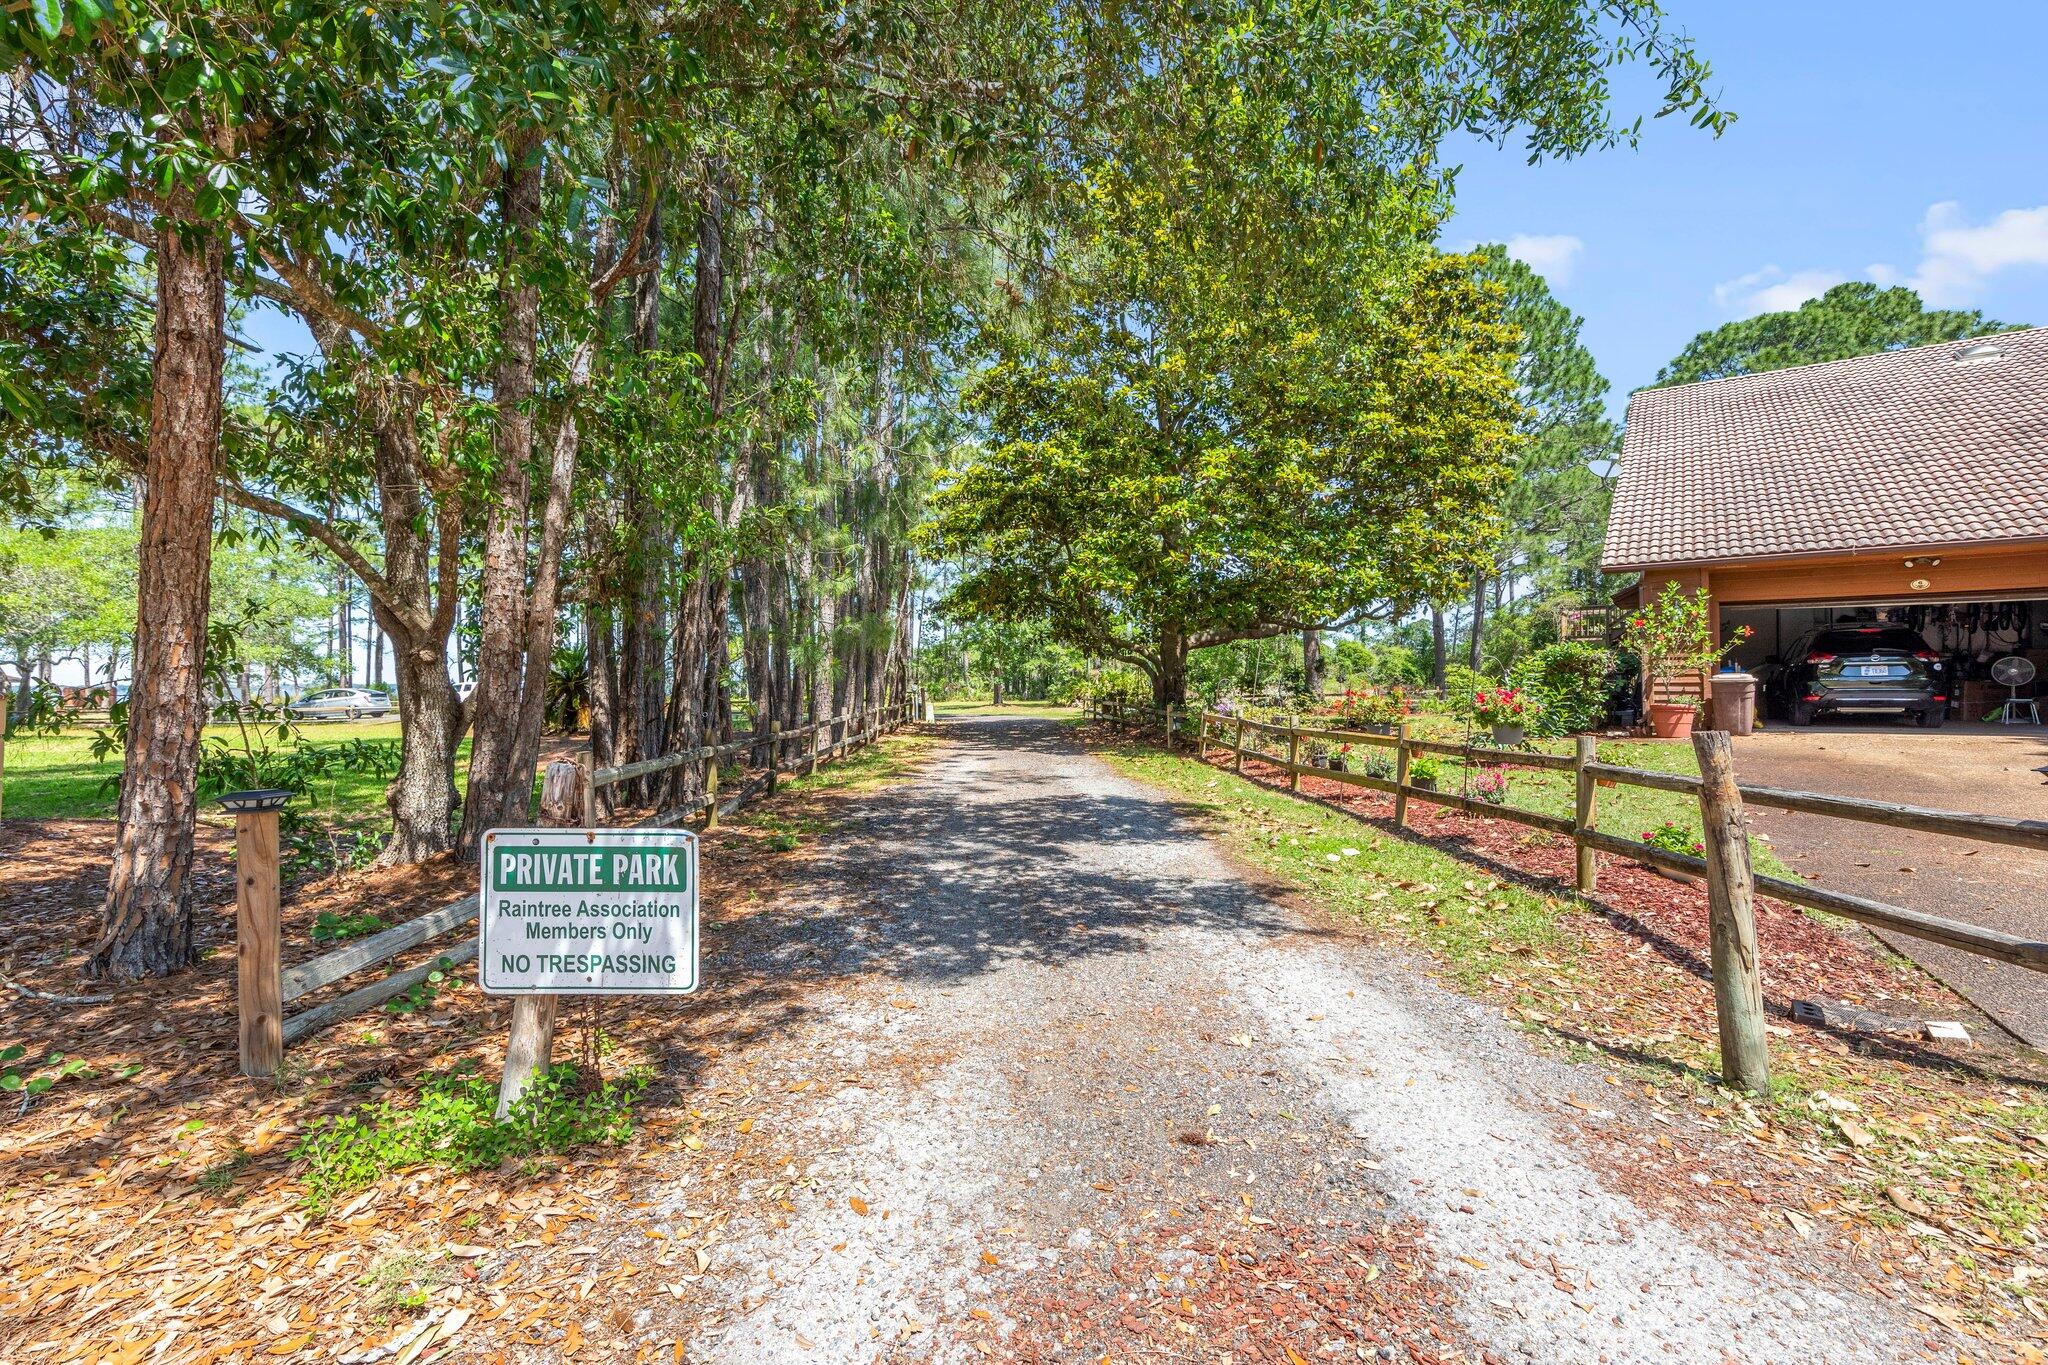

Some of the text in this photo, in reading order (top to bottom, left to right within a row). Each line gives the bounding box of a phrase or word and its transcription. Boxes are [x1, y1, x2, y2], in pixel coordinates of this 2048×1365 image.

[500, 854, 679, 885] PRIVATE PARK
[499, 900, 680, 918] Raintree Association
[526, 922, 652, 944] Members Only
[502, 955, 676, 973] NO TRESPASSING
